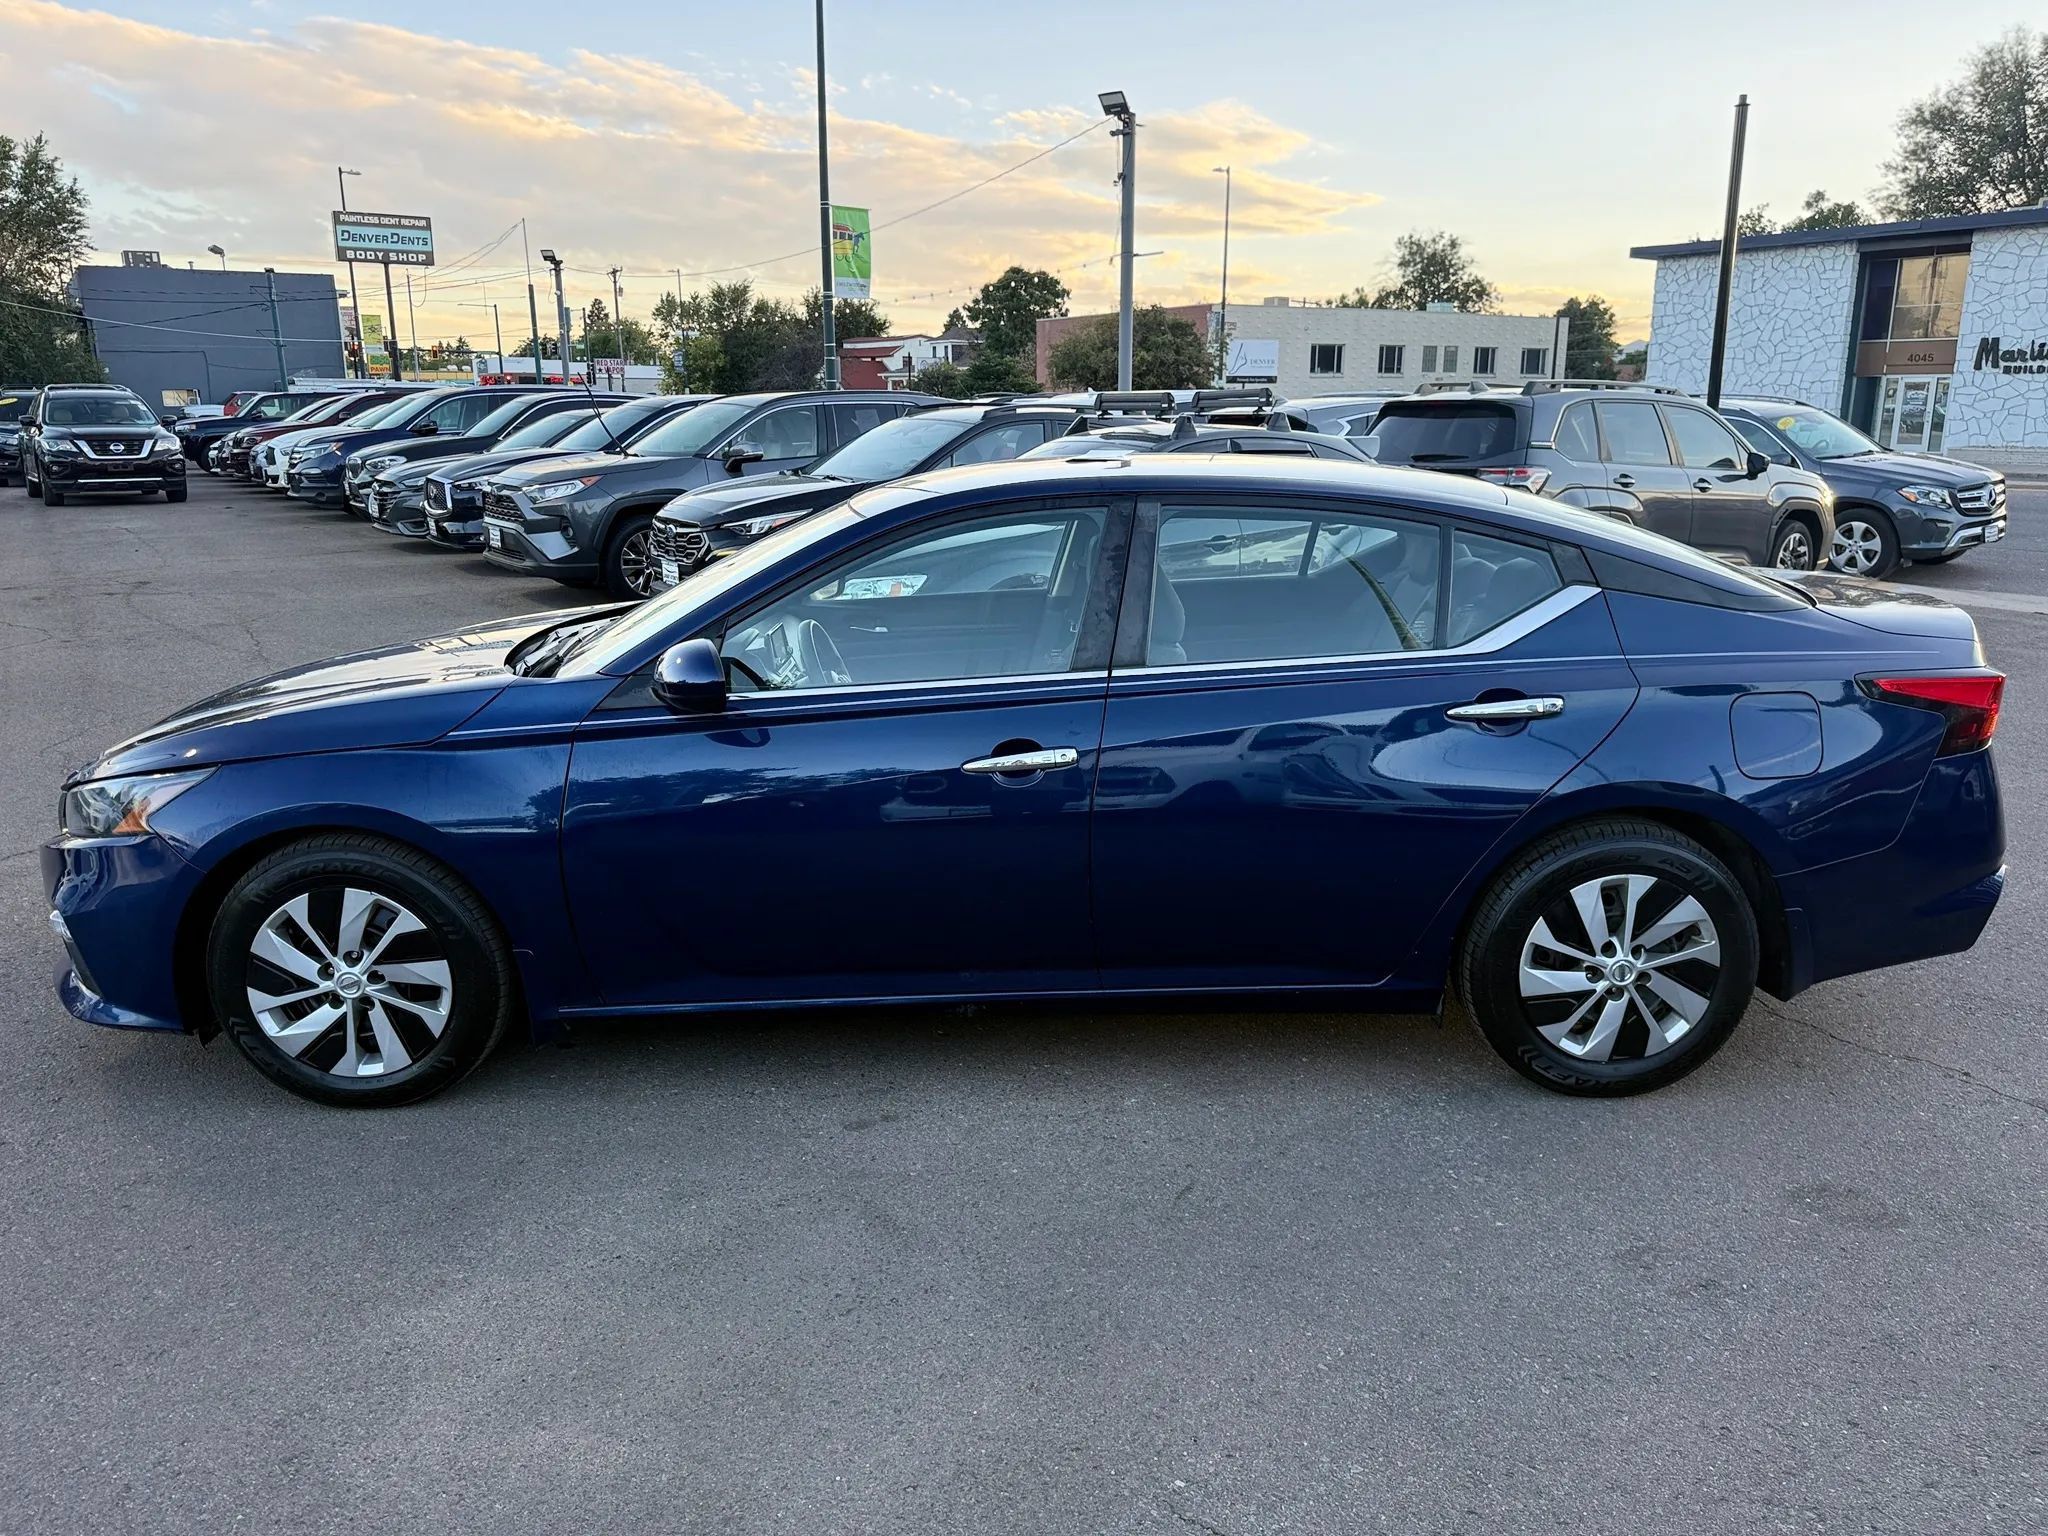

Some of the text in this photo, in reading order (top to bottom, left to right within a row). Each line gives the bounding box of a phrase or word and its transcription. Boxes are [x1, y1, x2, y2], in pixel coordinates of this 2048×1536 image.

[340, 214, 427, 227] PAINTLESS DENT REPAIR
[346, 250, 427, 262] BODY SHOP
[1907, 353, 1935, 363] 4045
[1973, 337, 2048, 370] Marli
[609, 359, 625, 367] STAR
[2002, 365, 2048, 375] BUILD
